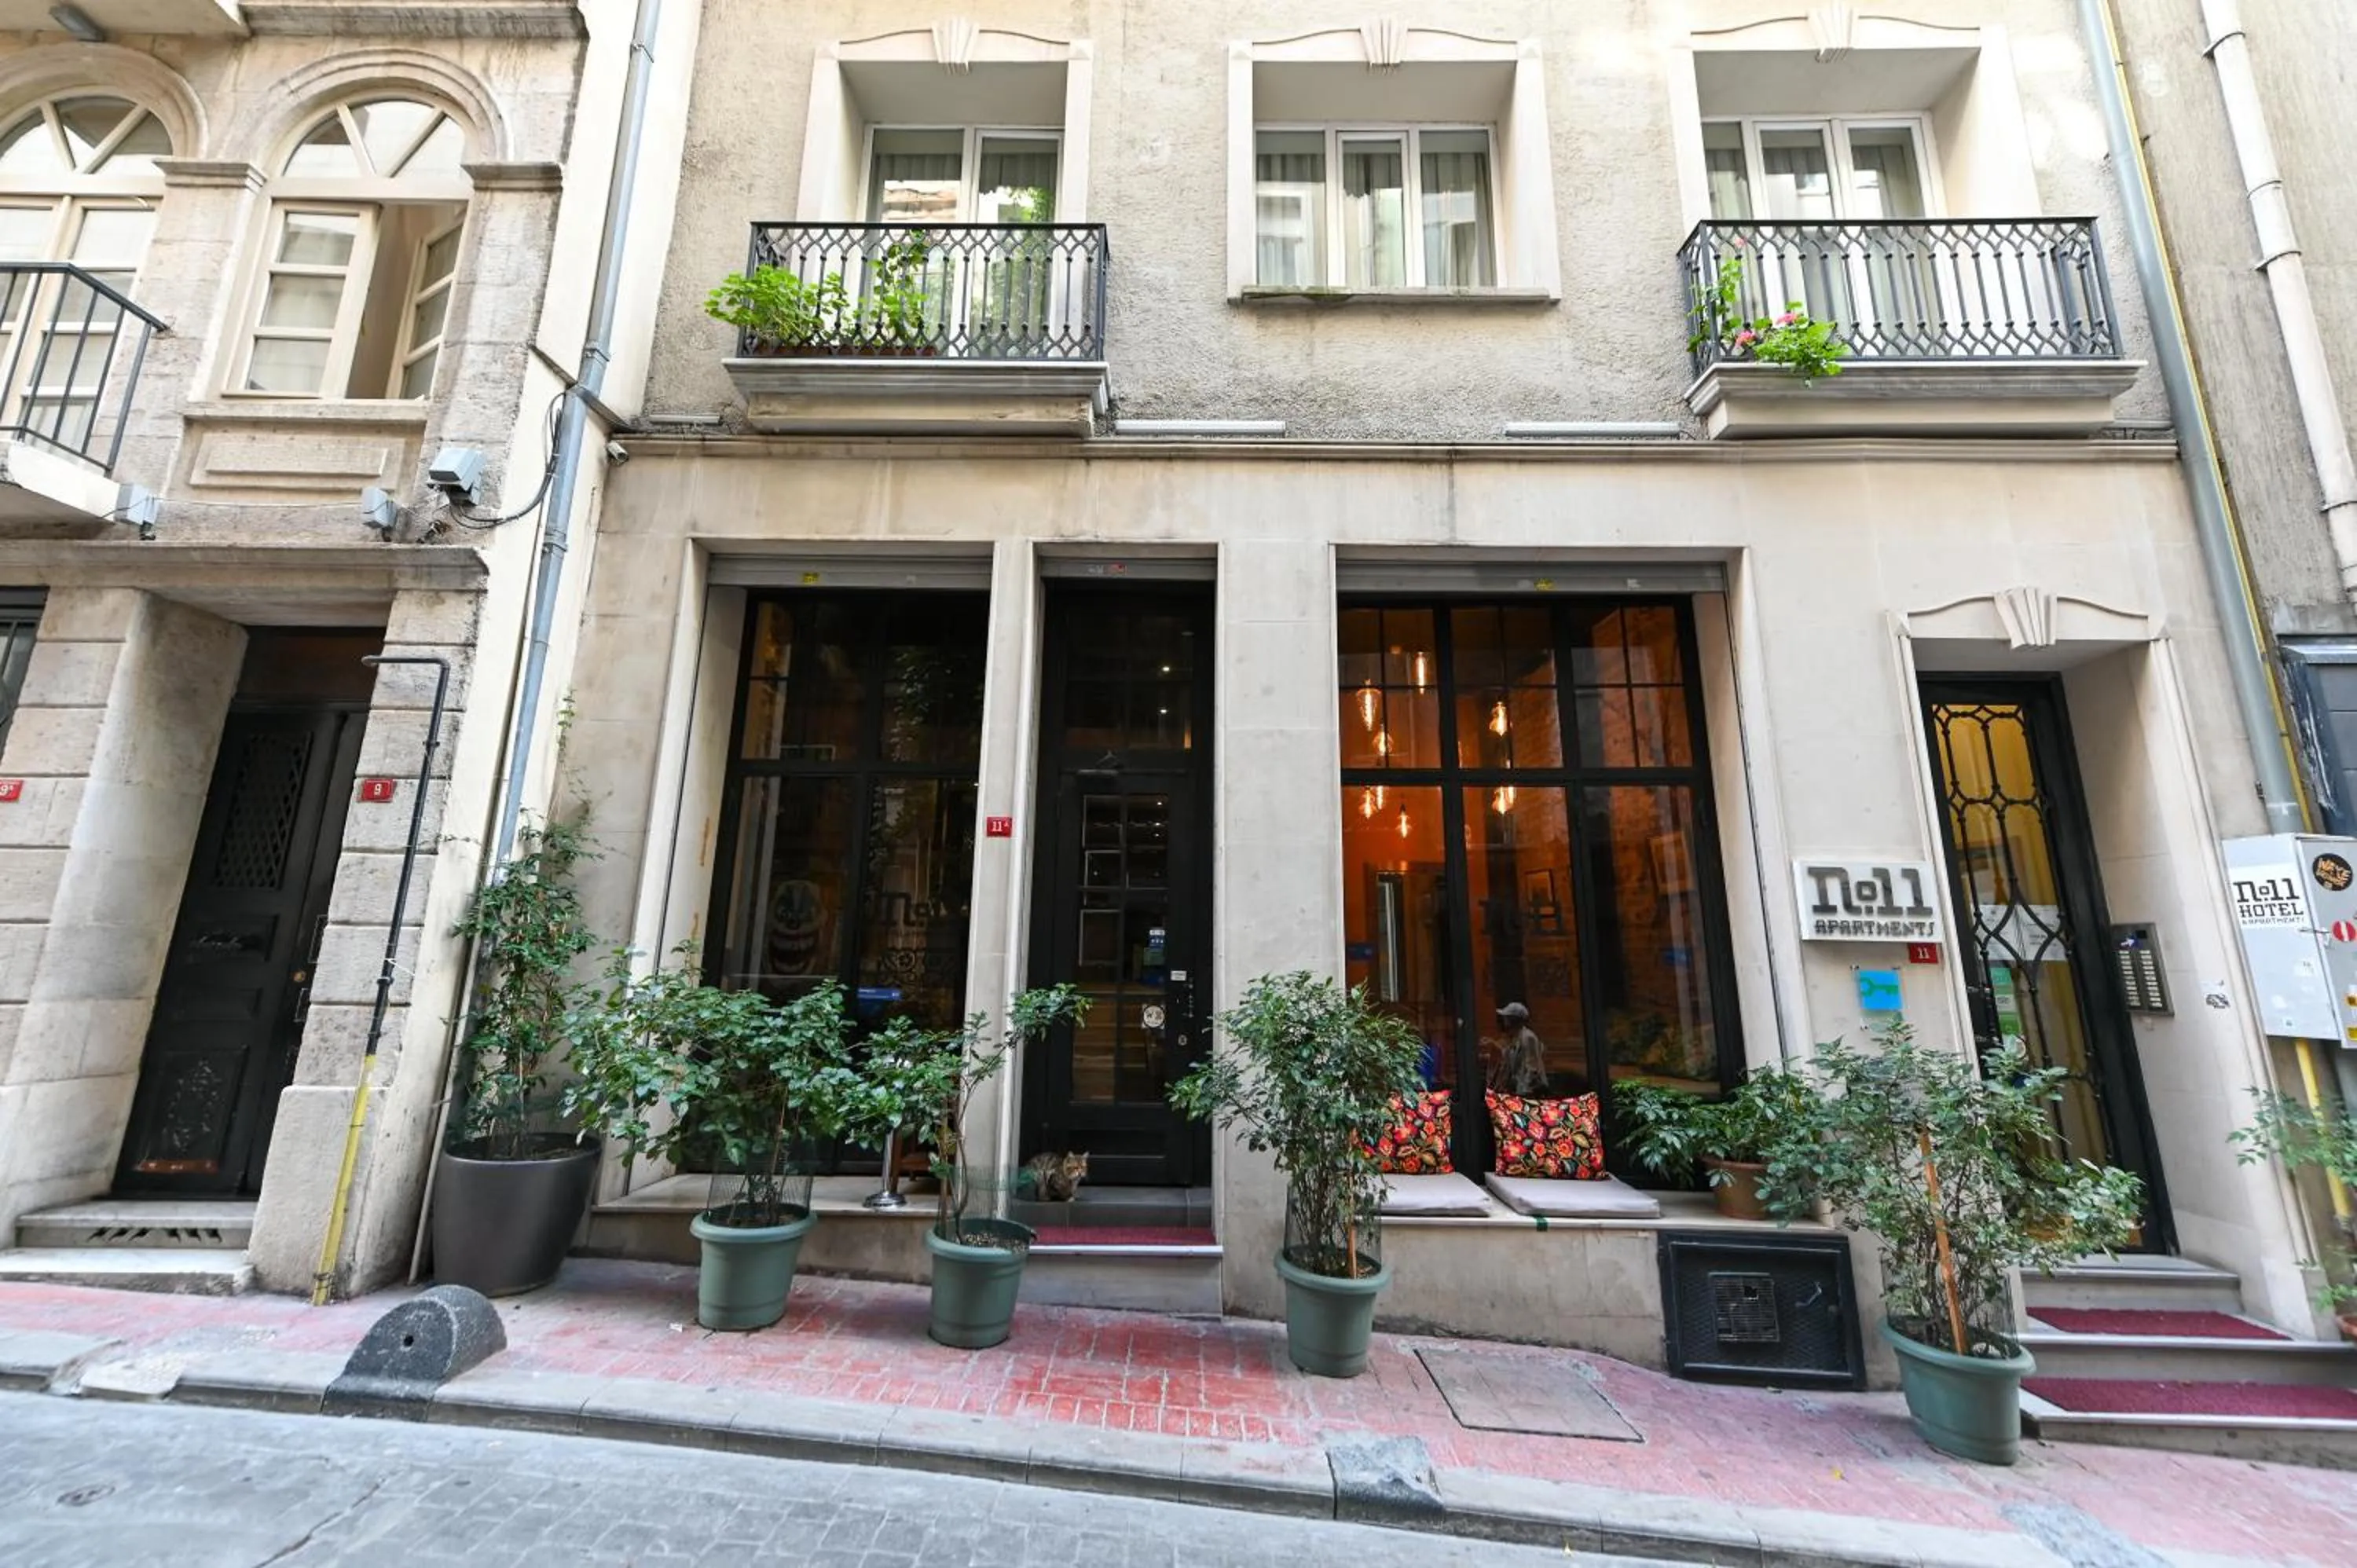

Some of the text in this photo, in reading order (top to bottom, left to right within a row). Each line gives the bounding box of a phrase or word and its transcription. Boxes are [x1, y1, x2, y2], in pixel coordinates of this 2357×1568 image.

[373, 783, 382, 796] 9
[2239, 903, 2304, 918] HOTEL
[1814, 919, 1934, 937] APARTMENTS
[1918, 947, 1930, 959] 11
